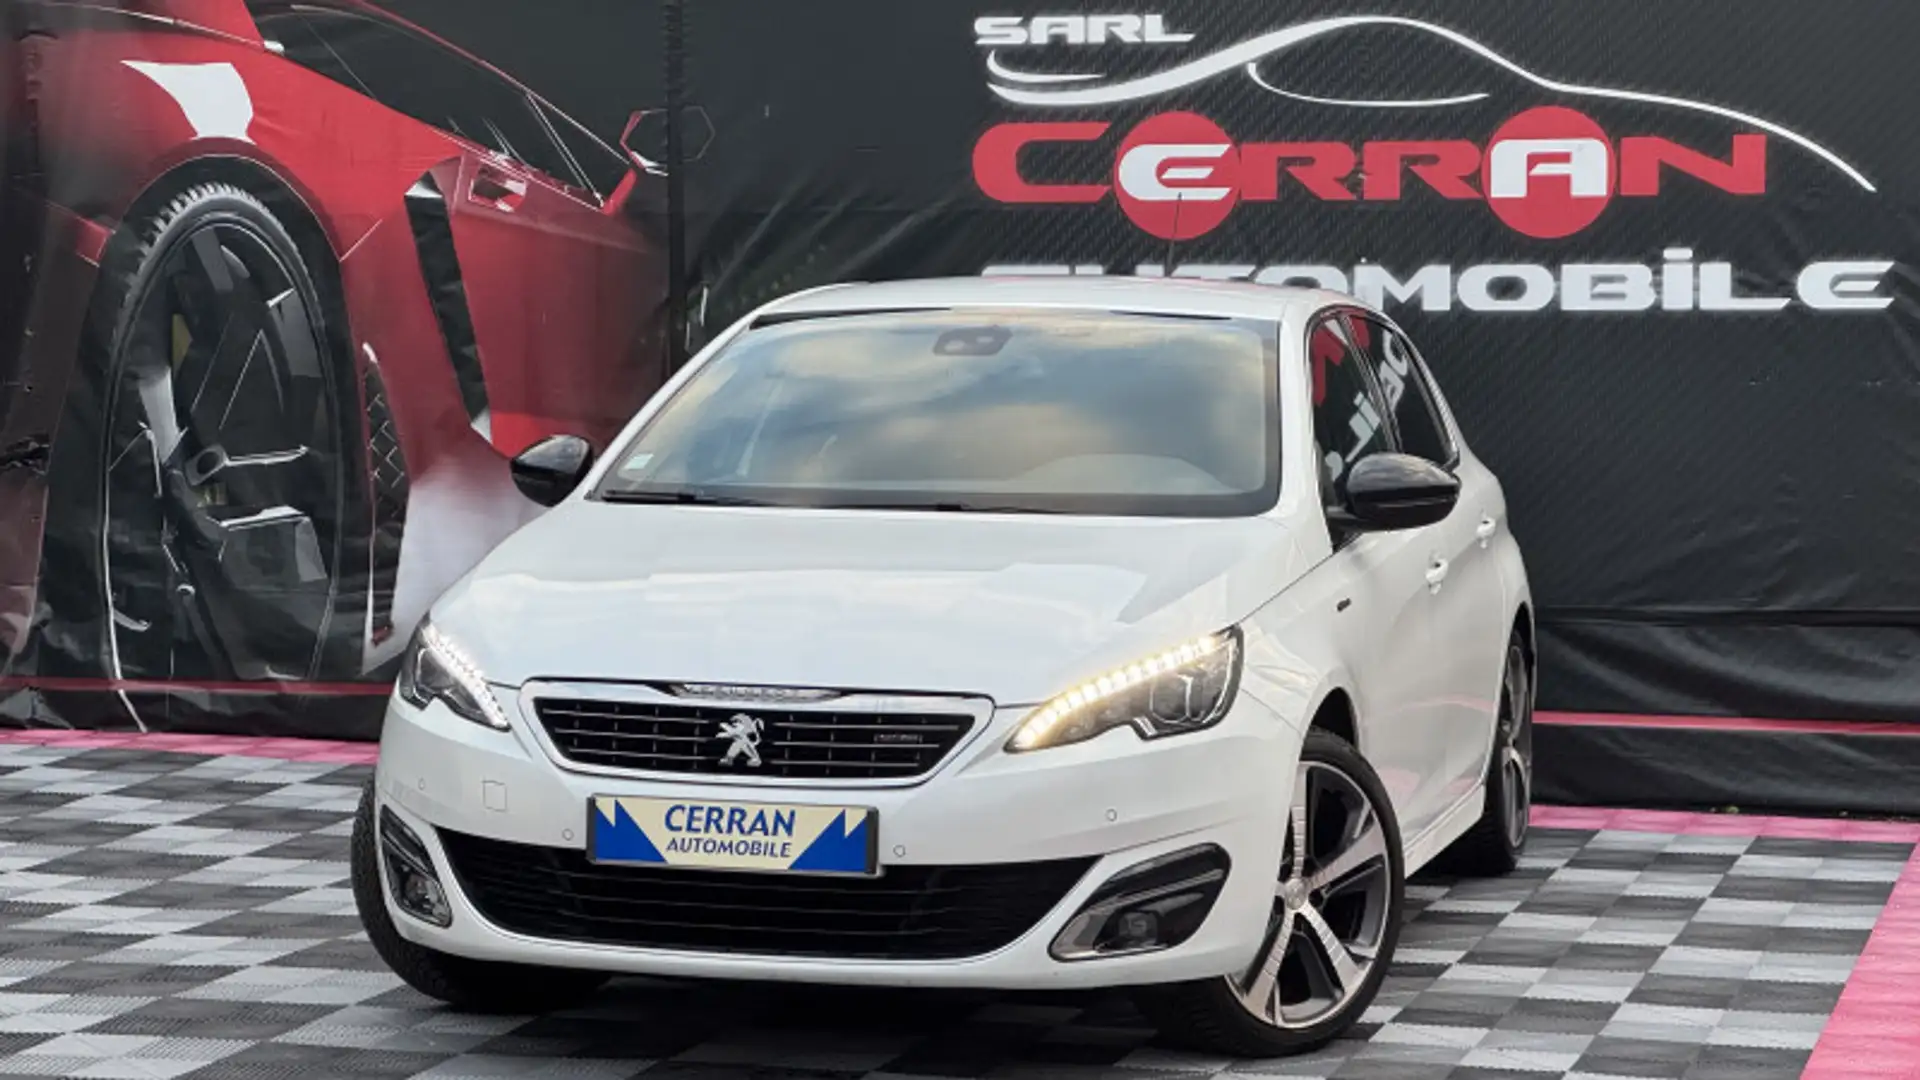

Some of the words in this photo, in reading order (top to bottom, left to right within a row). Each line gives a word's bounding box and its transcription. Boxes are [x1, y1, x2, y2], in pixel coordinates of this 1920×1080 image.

[974, 14, 1195, 45] SARL
[973, 121, 1767, 203] CERRAN
[664, 804, 796, 837] CERRAN
[666, 837, 793, 858] AUTOMOBILE
